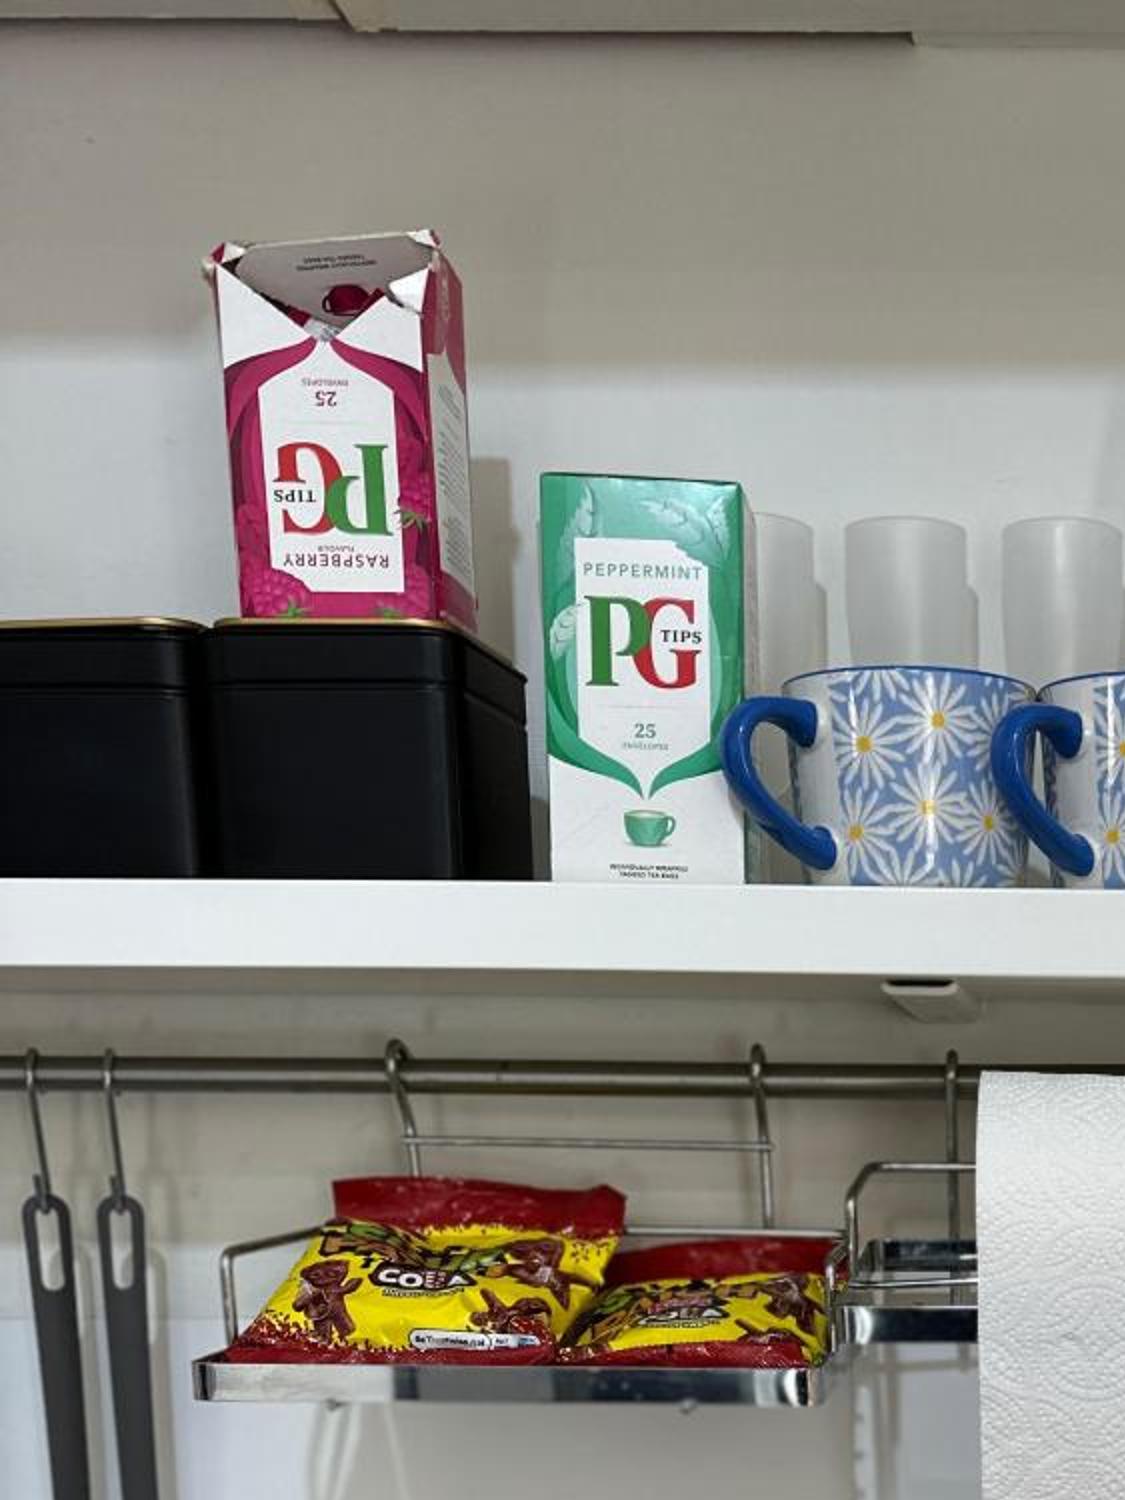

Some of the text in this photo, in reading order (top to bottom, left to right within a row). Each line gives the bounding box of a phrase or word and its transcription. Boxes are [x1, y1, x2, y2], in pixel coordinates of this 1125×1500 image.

[315, 391, 337, 407] 25
[272, 442, 393, 536] PG
[273, 489, 316, 503] TIPS
[283, 552, 389, 568] RASPBERRY
[583, 562, 702, 580] PEPPERMINT
[583, 595, 702, 690] PG
[660, 629, 702, 644] TIPS
[635, 723, 657, 739] 25
